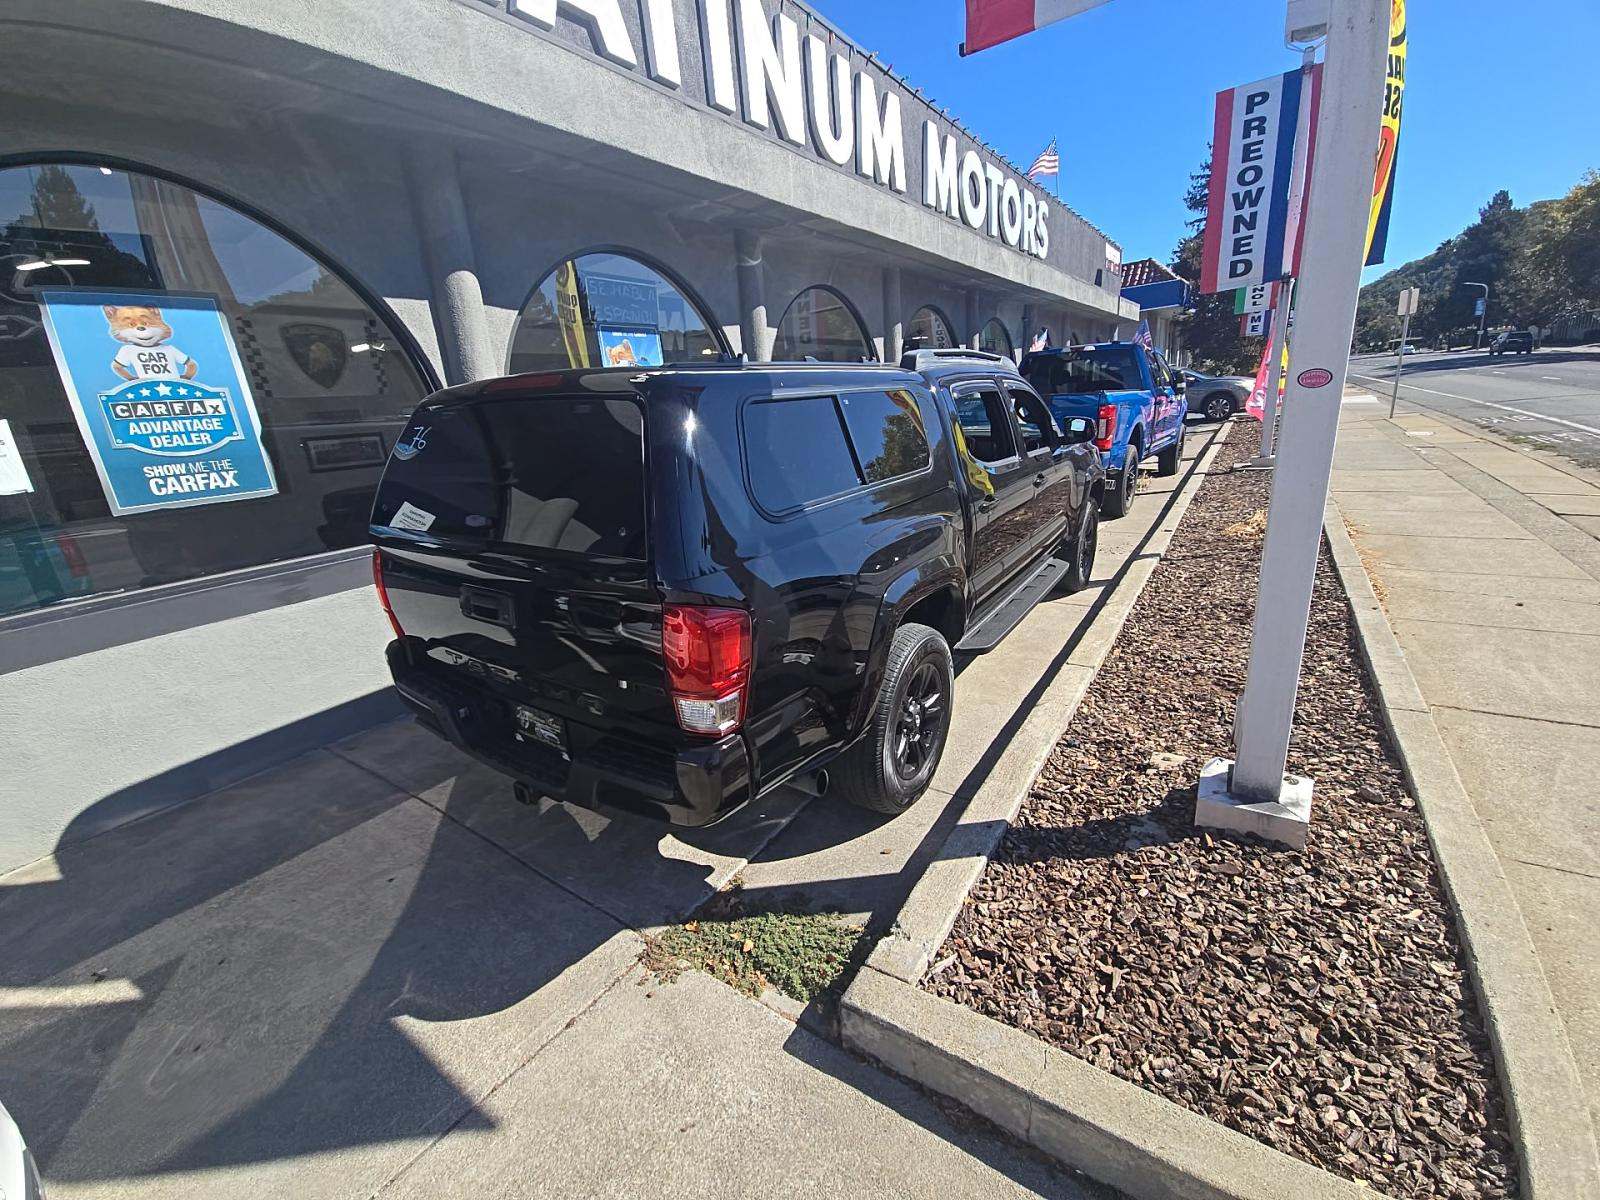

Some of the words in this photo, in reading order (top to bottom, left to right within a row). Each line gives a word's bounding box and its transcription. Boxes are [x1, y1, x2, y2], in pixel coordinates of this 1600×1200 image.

[923, 119, 1049, 260] MOTORS
[1229, 91, 1269, 279] PREOWNED
[137, 352, 169, 363] CAR
[143, 363, 171, 375] FOX
[113, 402, 223, 419] CARFAX
[129, 418, 224, 436] ADVANTAGE
[149, 433, 213, 449] DEALER
[143, 462, 187, 478] SHOW
[189, 461, 209, 474] ME
[209, 458, 233, 471] THE
[150, 470, 240, 497] CARFAX
